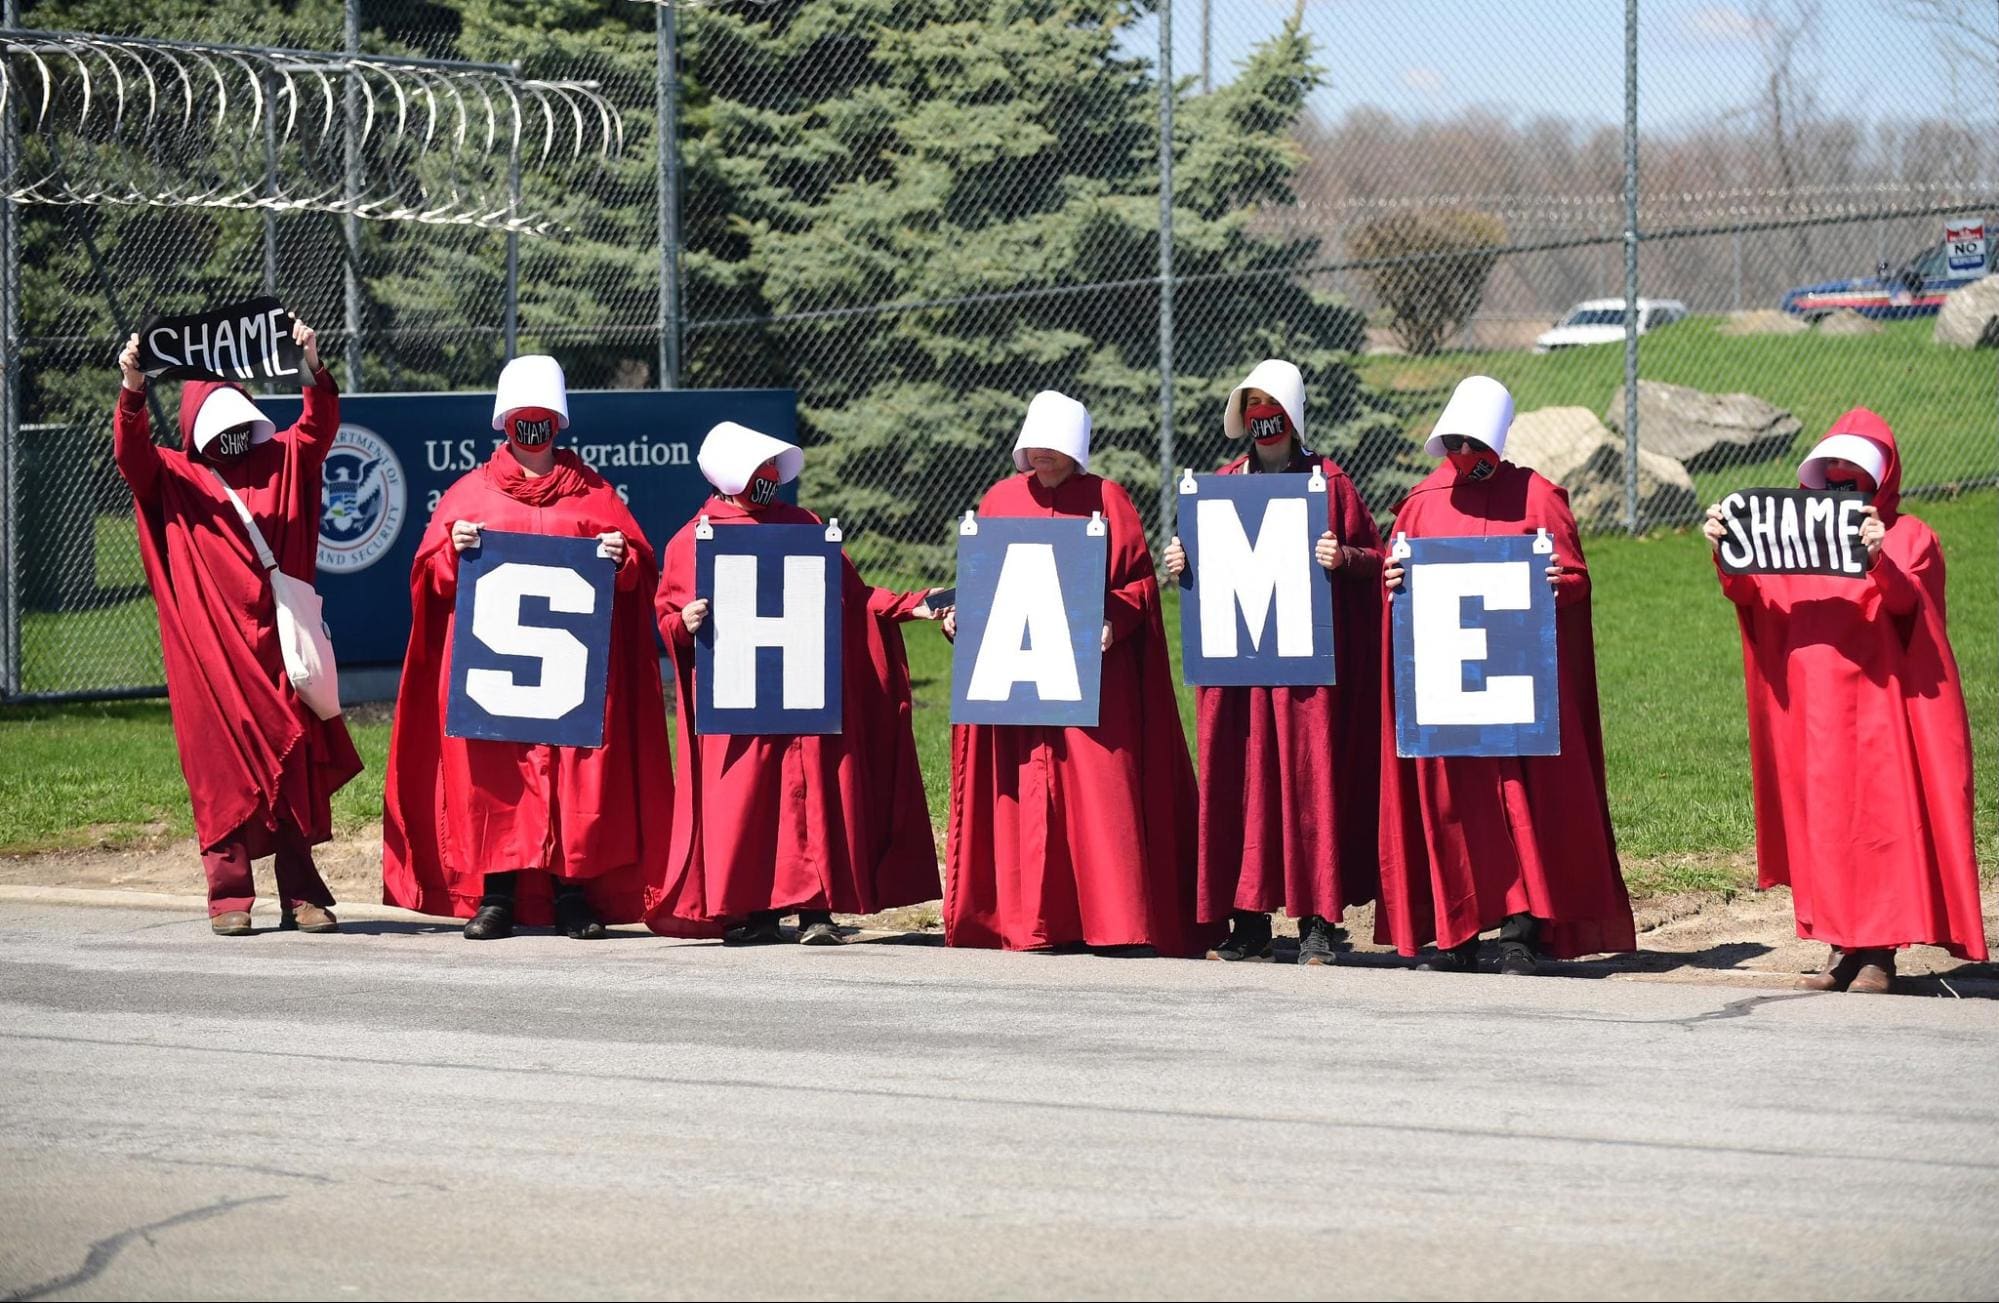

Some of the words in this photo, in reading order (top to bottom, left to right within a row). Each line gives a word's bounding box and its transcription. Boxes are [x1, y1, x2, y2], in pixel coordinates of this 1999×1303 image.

[1954, 242, 1977, 255] NO
[148, 307, 299, 379] SHAME
[425, 439, 482, 471] U.S.
[516, 419, 550, 446] SHAME
[1250, 414, 1283, 438] SHAME
[351, 505, 399, 564] SECURITY
[1720, 492, 1864, 573] SHAME
[1196, 498, 1314, 657] M
[466, 562, 595, 719] S
[713, 555, 825, 709] H
[966, 543, 1082, 700] A
[1412, 562, 1535, 725] E
